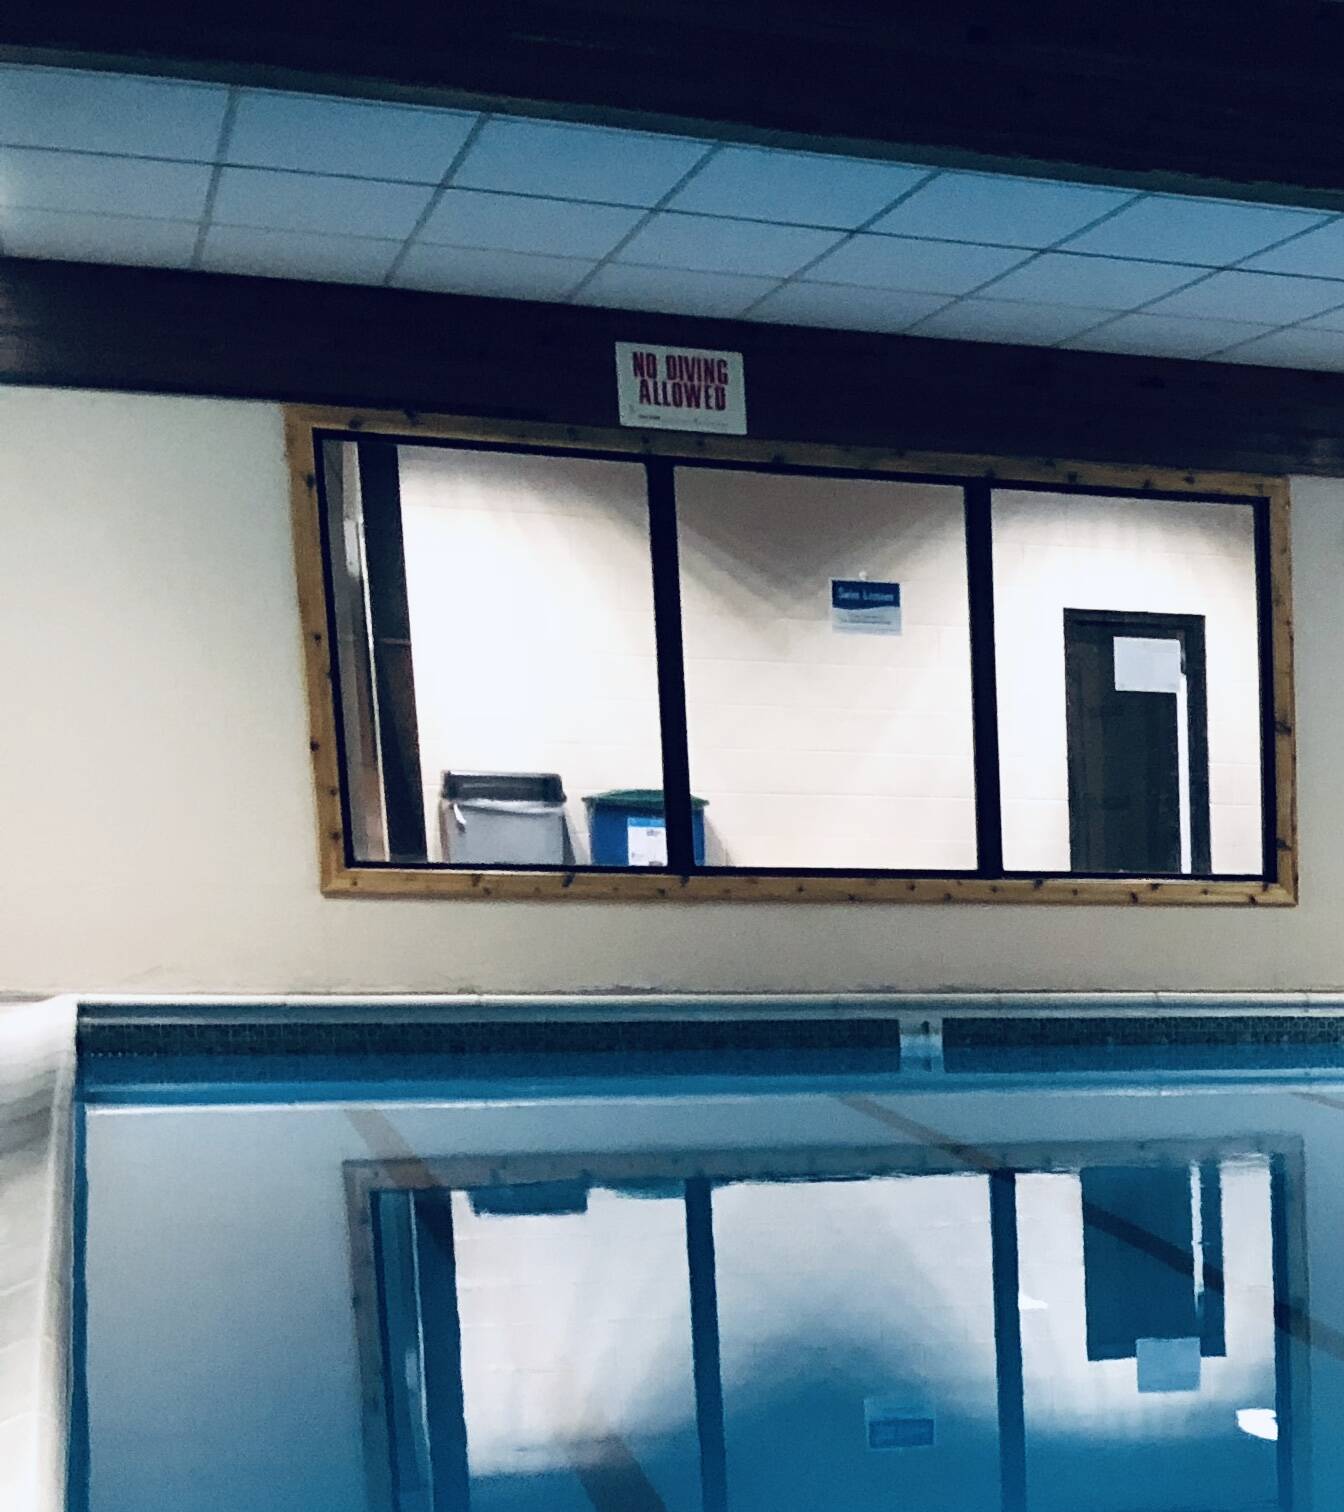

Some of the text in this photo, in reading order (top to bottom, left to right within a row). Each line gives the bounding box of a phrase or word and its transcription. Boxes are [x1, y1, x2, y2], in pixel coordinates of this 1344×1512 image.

[632, 351, 728, 386] NO DIVING
[639, 379, 727, 411] ALLOWED
